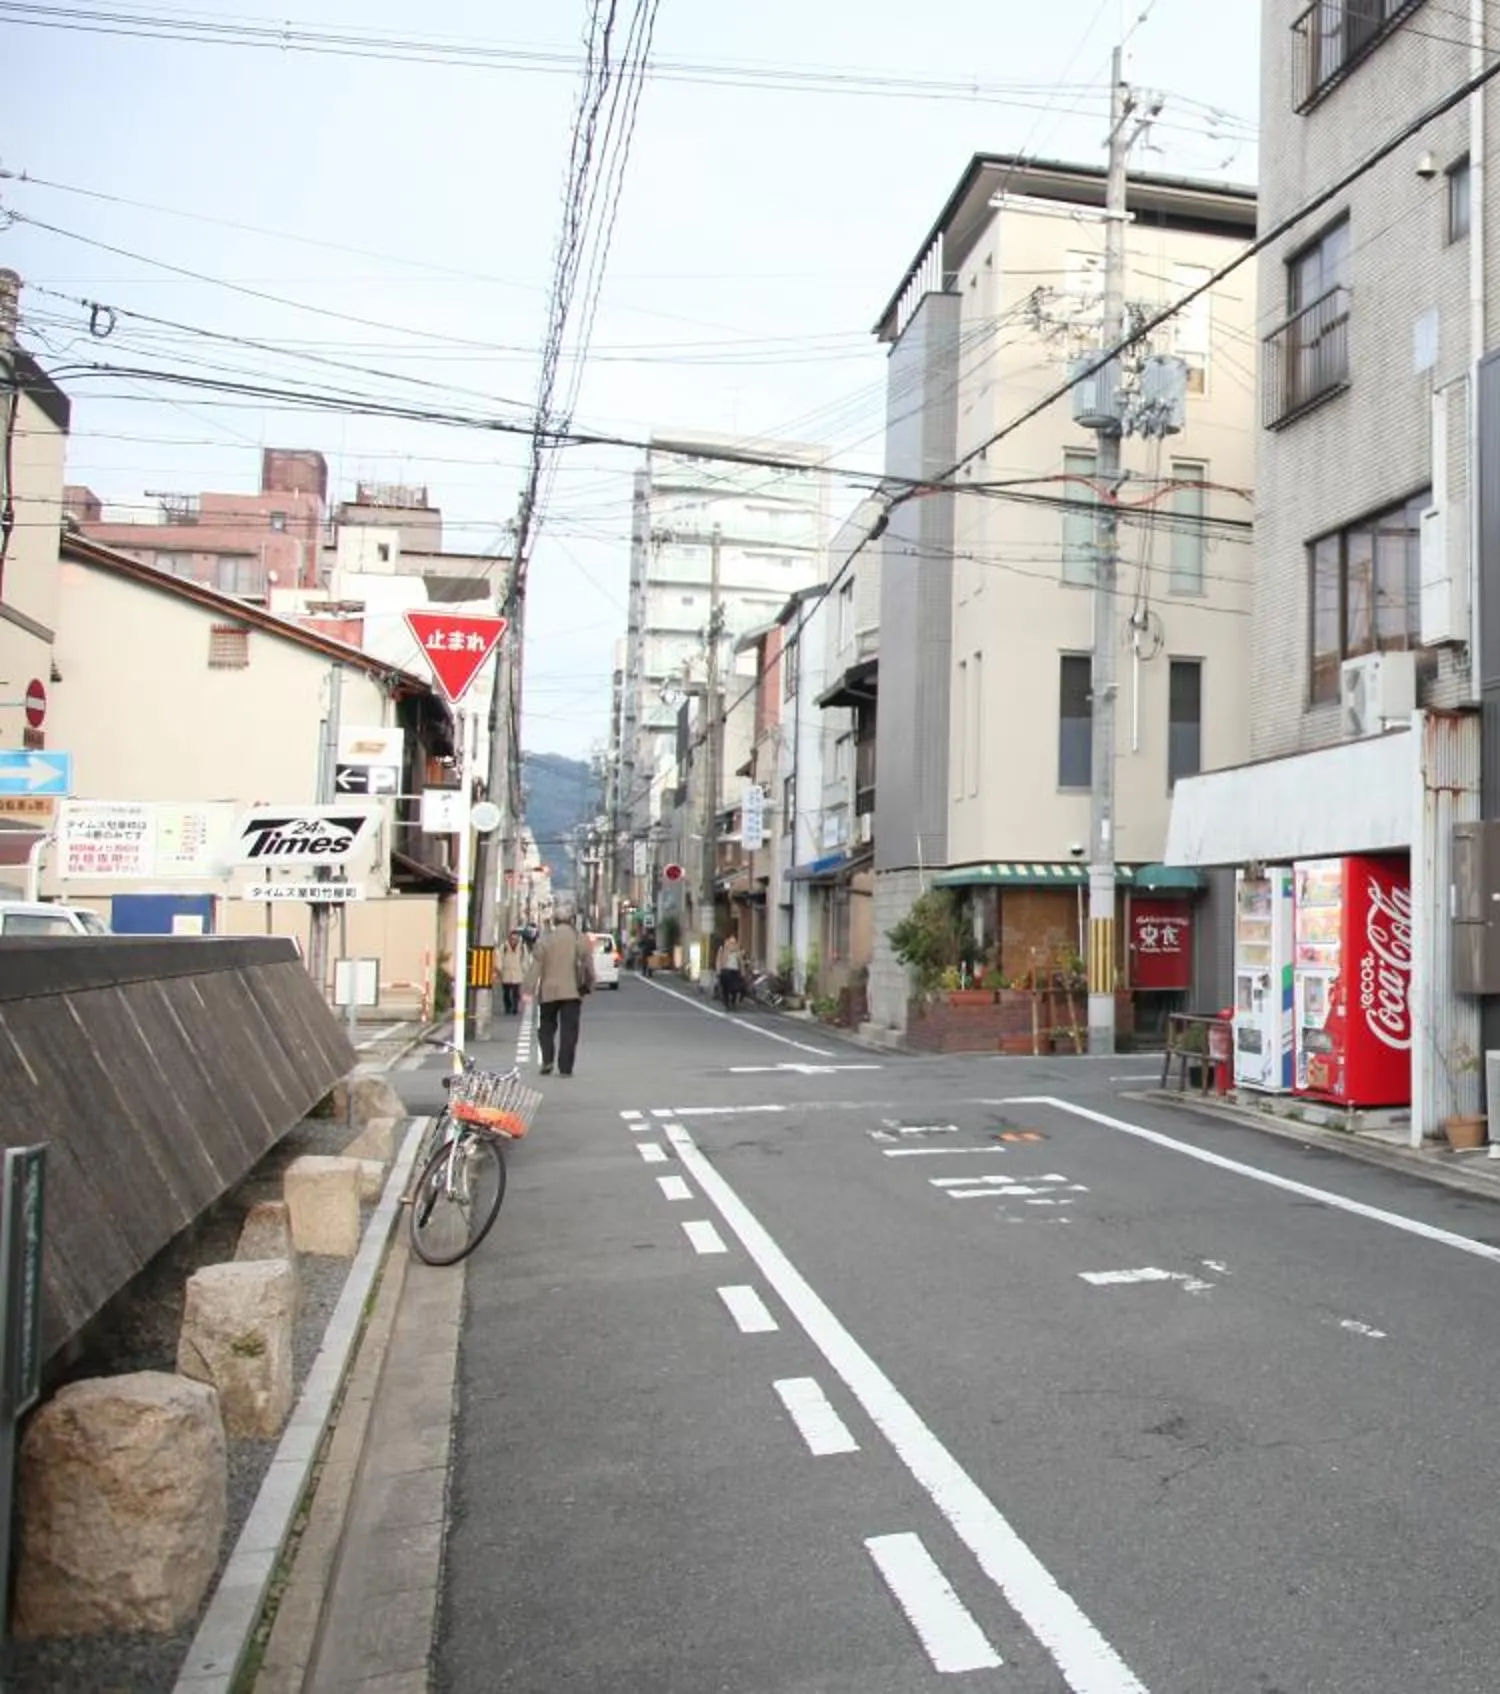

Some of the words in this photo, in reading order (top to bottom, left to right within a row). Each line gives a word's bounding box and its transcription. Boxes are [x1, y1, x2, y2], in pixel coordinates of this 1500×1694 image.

[426, 629, 486, 652] 止まれ
[368, 767, 395, 793] P
[243, 820, 356, 858] Times
[1366, 874, 1411, 1050] Coca-Cola
